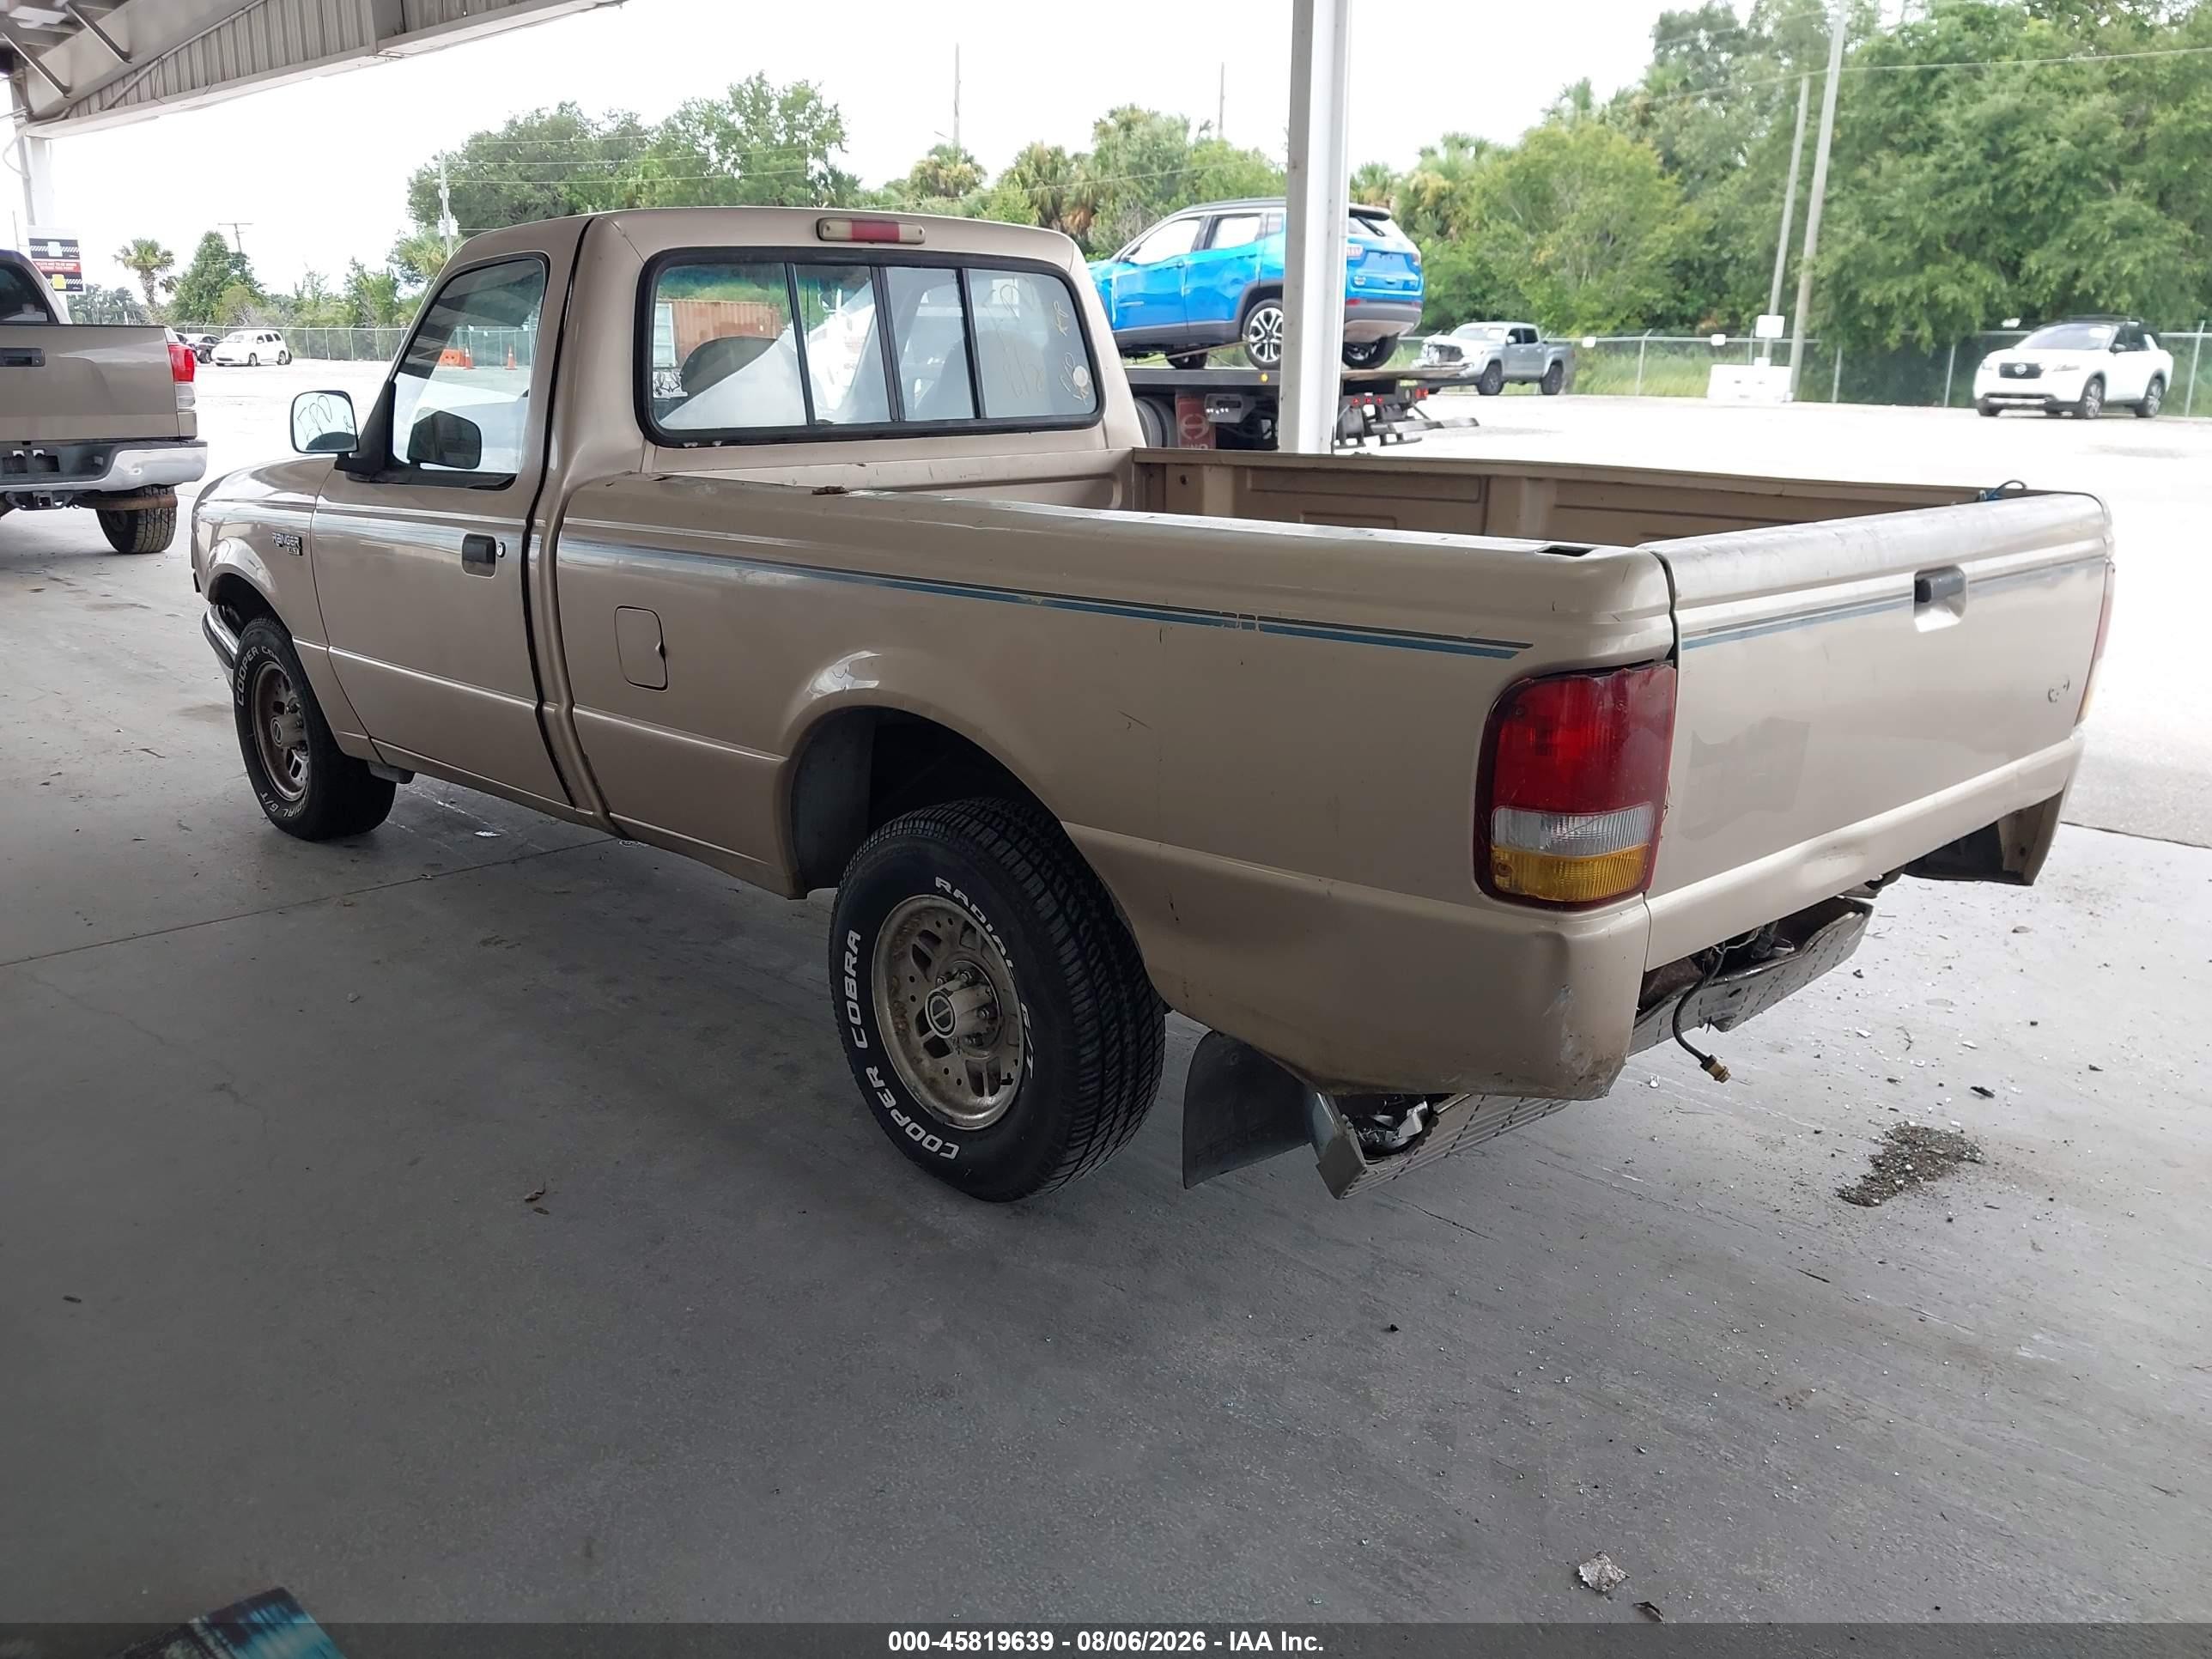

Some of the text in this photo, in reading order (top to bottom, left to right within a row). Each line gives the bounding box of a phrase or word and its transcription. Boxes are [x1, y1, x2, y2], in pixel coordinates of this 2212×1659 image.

[271, 532, 300, 549] RANGER
[236, 646, 259, 706] COOPER
[260, 791, 279, 812] G/T
[935, 876, 1015, 981] RADIAL
[844, 929, 959, 1159] COOPER COBRA
